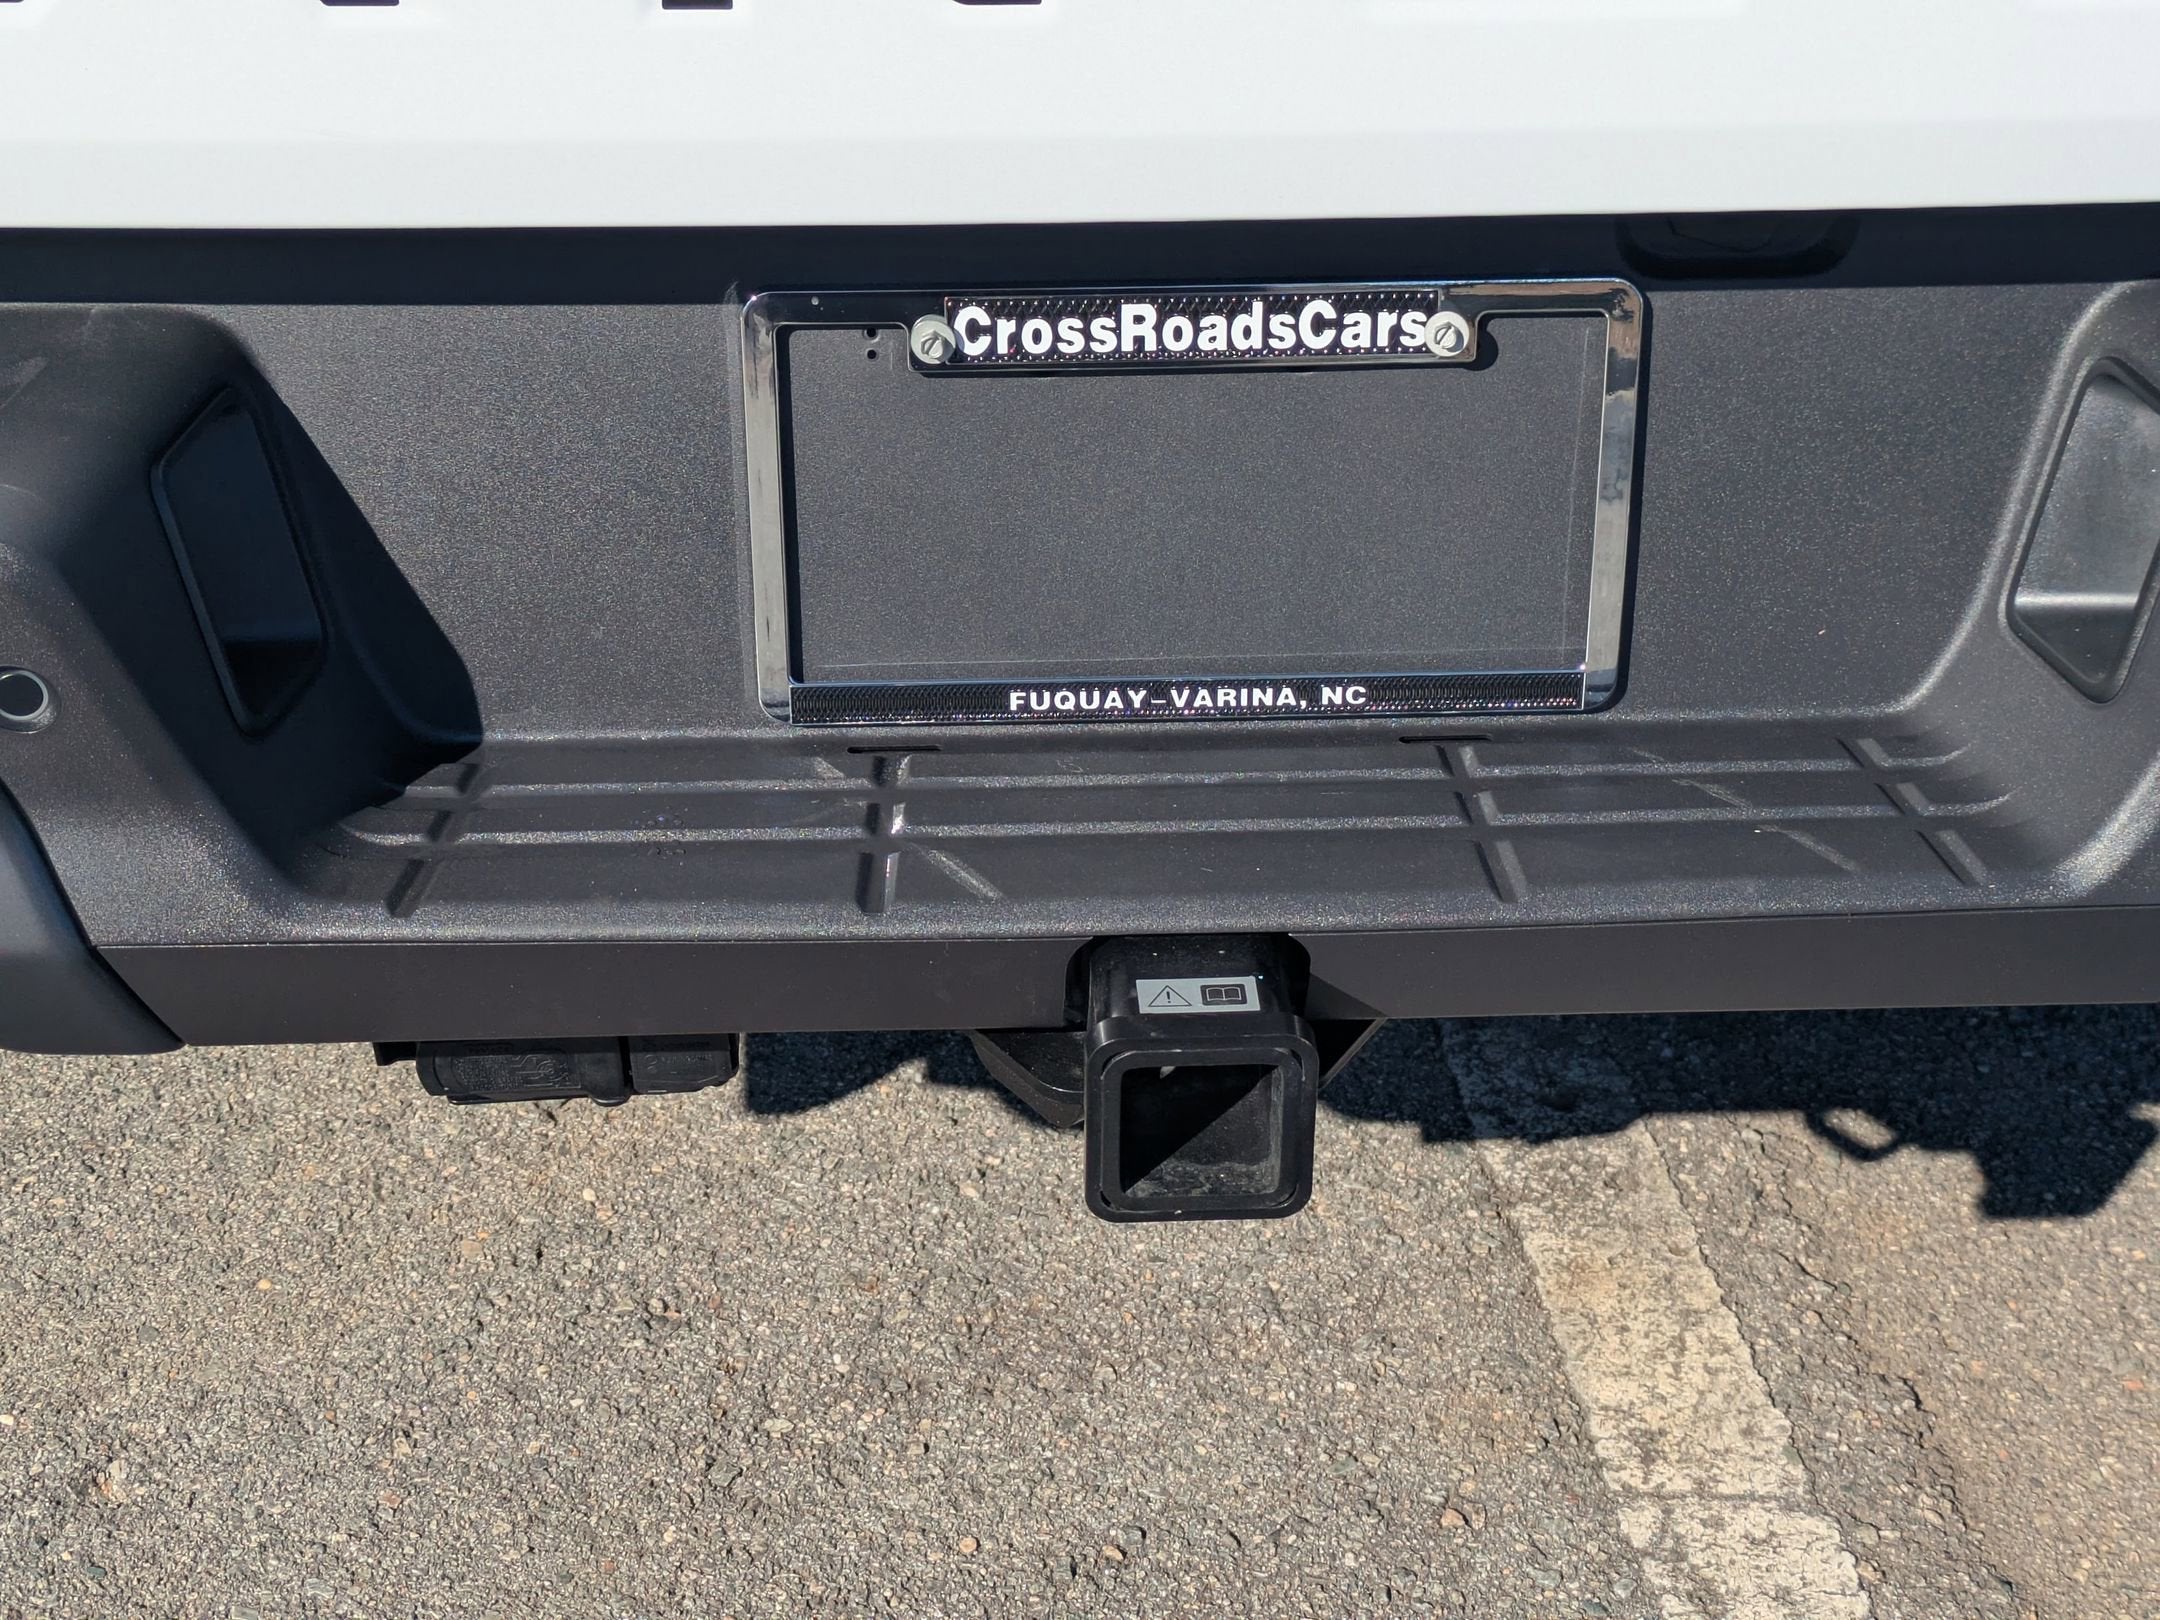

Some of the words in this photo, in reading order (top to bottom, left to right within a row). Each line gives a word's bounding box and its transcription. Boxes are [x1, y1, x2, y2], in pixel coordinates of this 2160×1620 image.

[953, 299, 1427, 356] CrossRoadsCars
[1009, 687, 1307, 711] FUQUAY-VARINA,
[1321, 685, 1367, 706] NC
